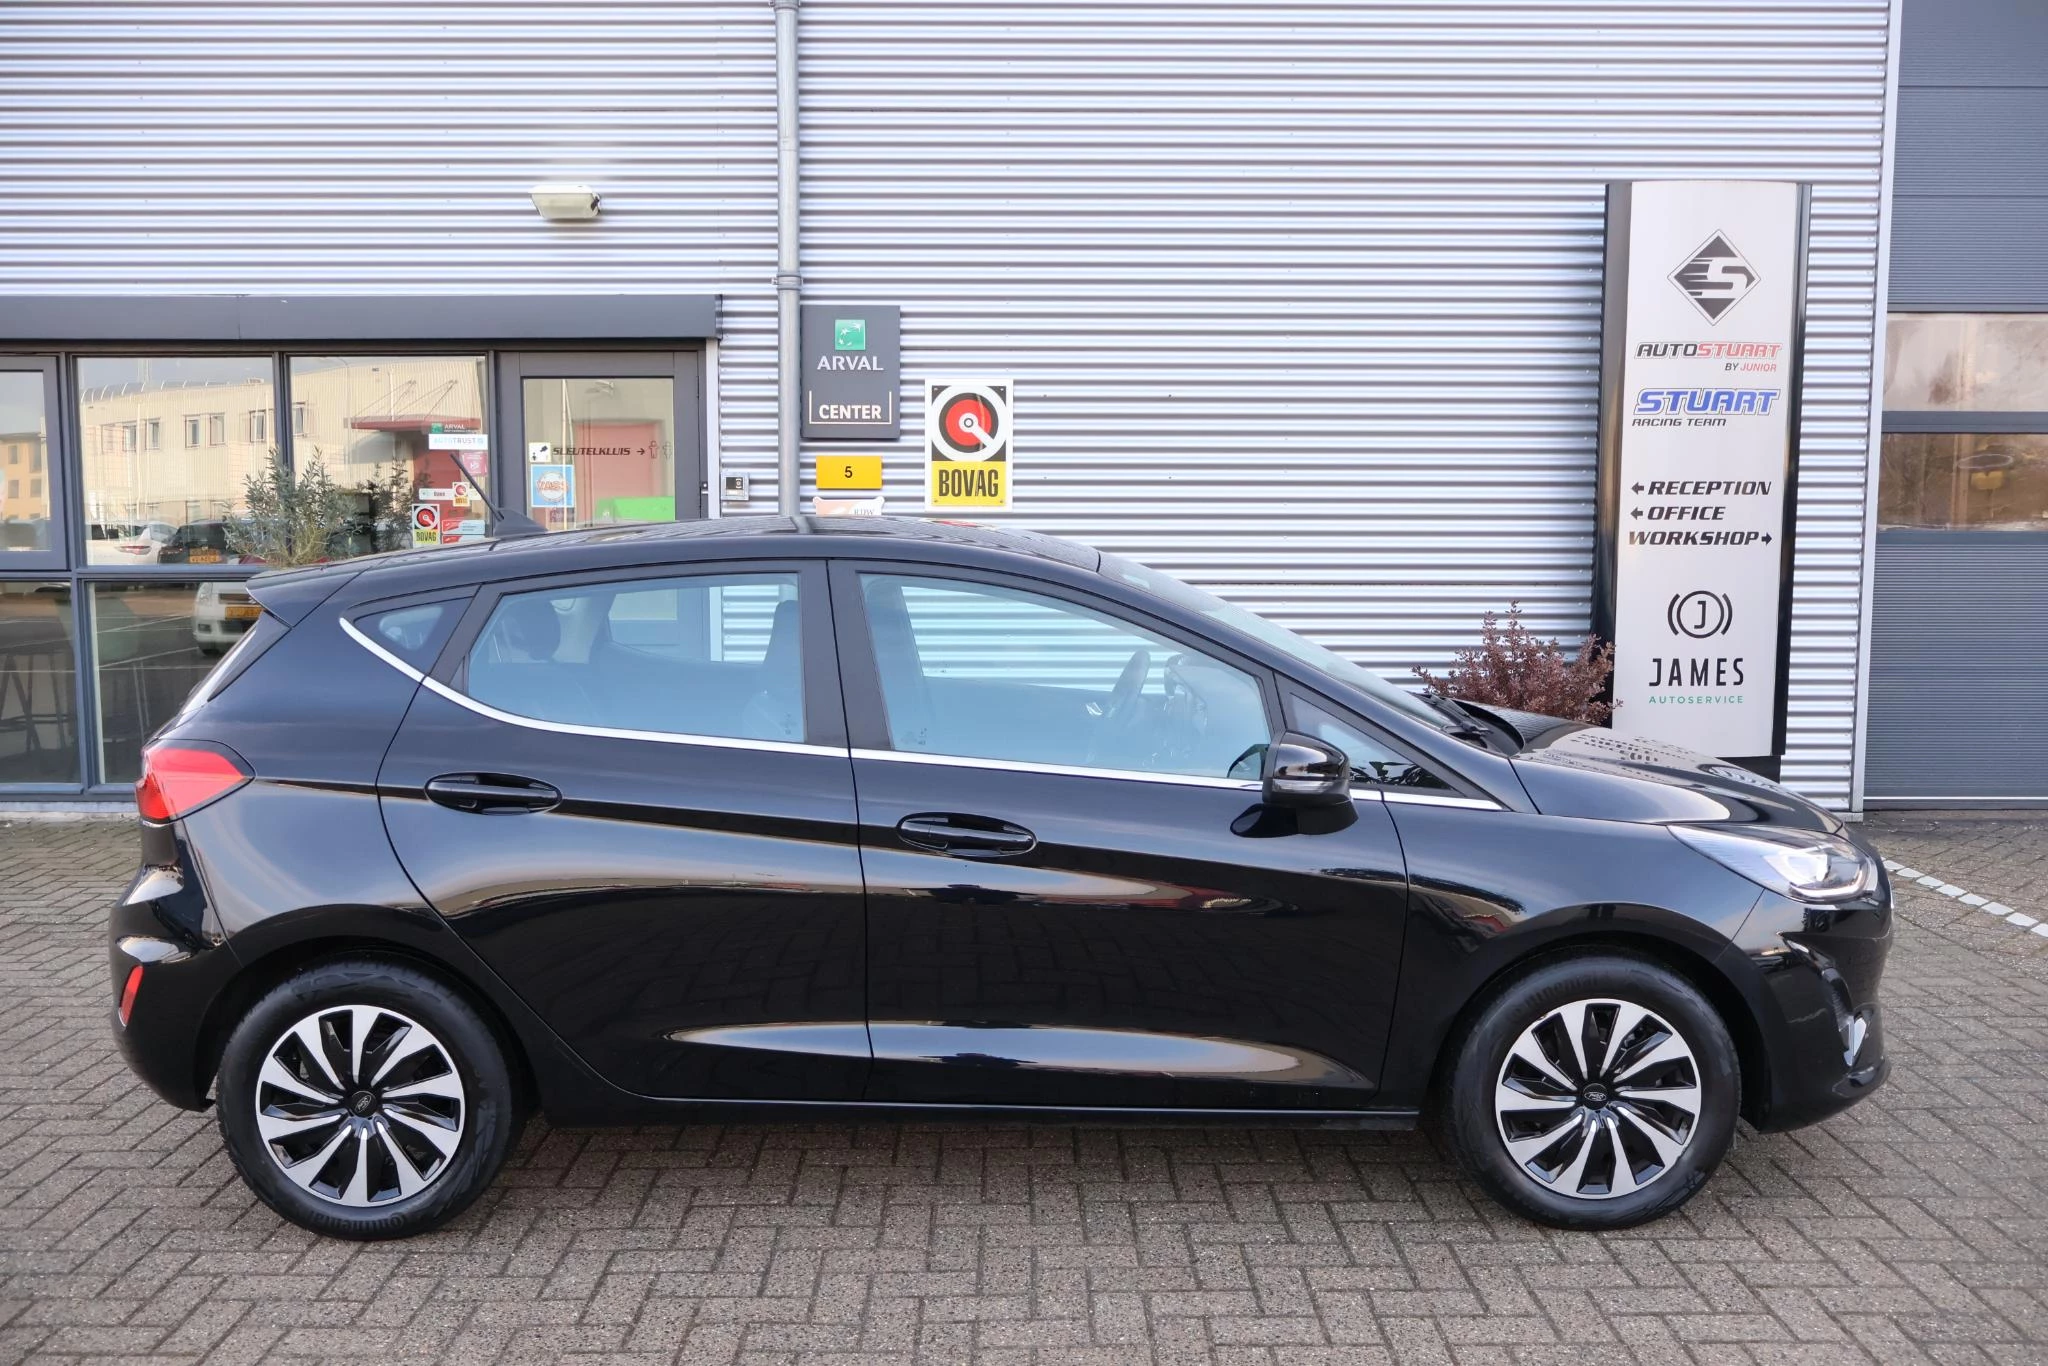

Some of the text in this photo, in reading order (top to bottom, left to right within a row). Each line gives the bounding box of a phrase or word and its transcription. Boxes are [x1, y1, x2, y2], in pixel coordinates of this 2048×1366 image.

[1635, 342, 1782, 358] AUTOSTUART
[817, 355, 884, 371] ARVAL
[1725, 363, 1777, 372] BY JUNIOR
[1634, 388, 1781, 415] STUART
[818, 404, 882, 419] CENTER
[1632, 418, 1727, 427] RACING TEAM
[552, 446, 631, 456] SLEUTELKLUIS
[844, 466, 853, 478] 5
[938, 468, 999, 498] BOVAG
[1648, 481, 1772, 495] RECEPTION
[1647, 506, 1726, 520] OFFICE
[416, 531, 437, 542] BOVAG
[1628, 531, 1760, 545] WORKSHOP
[1648, 658, 1744, 687] JAMES
[1648, 695, 1744, 705] AUTOSERVICE
